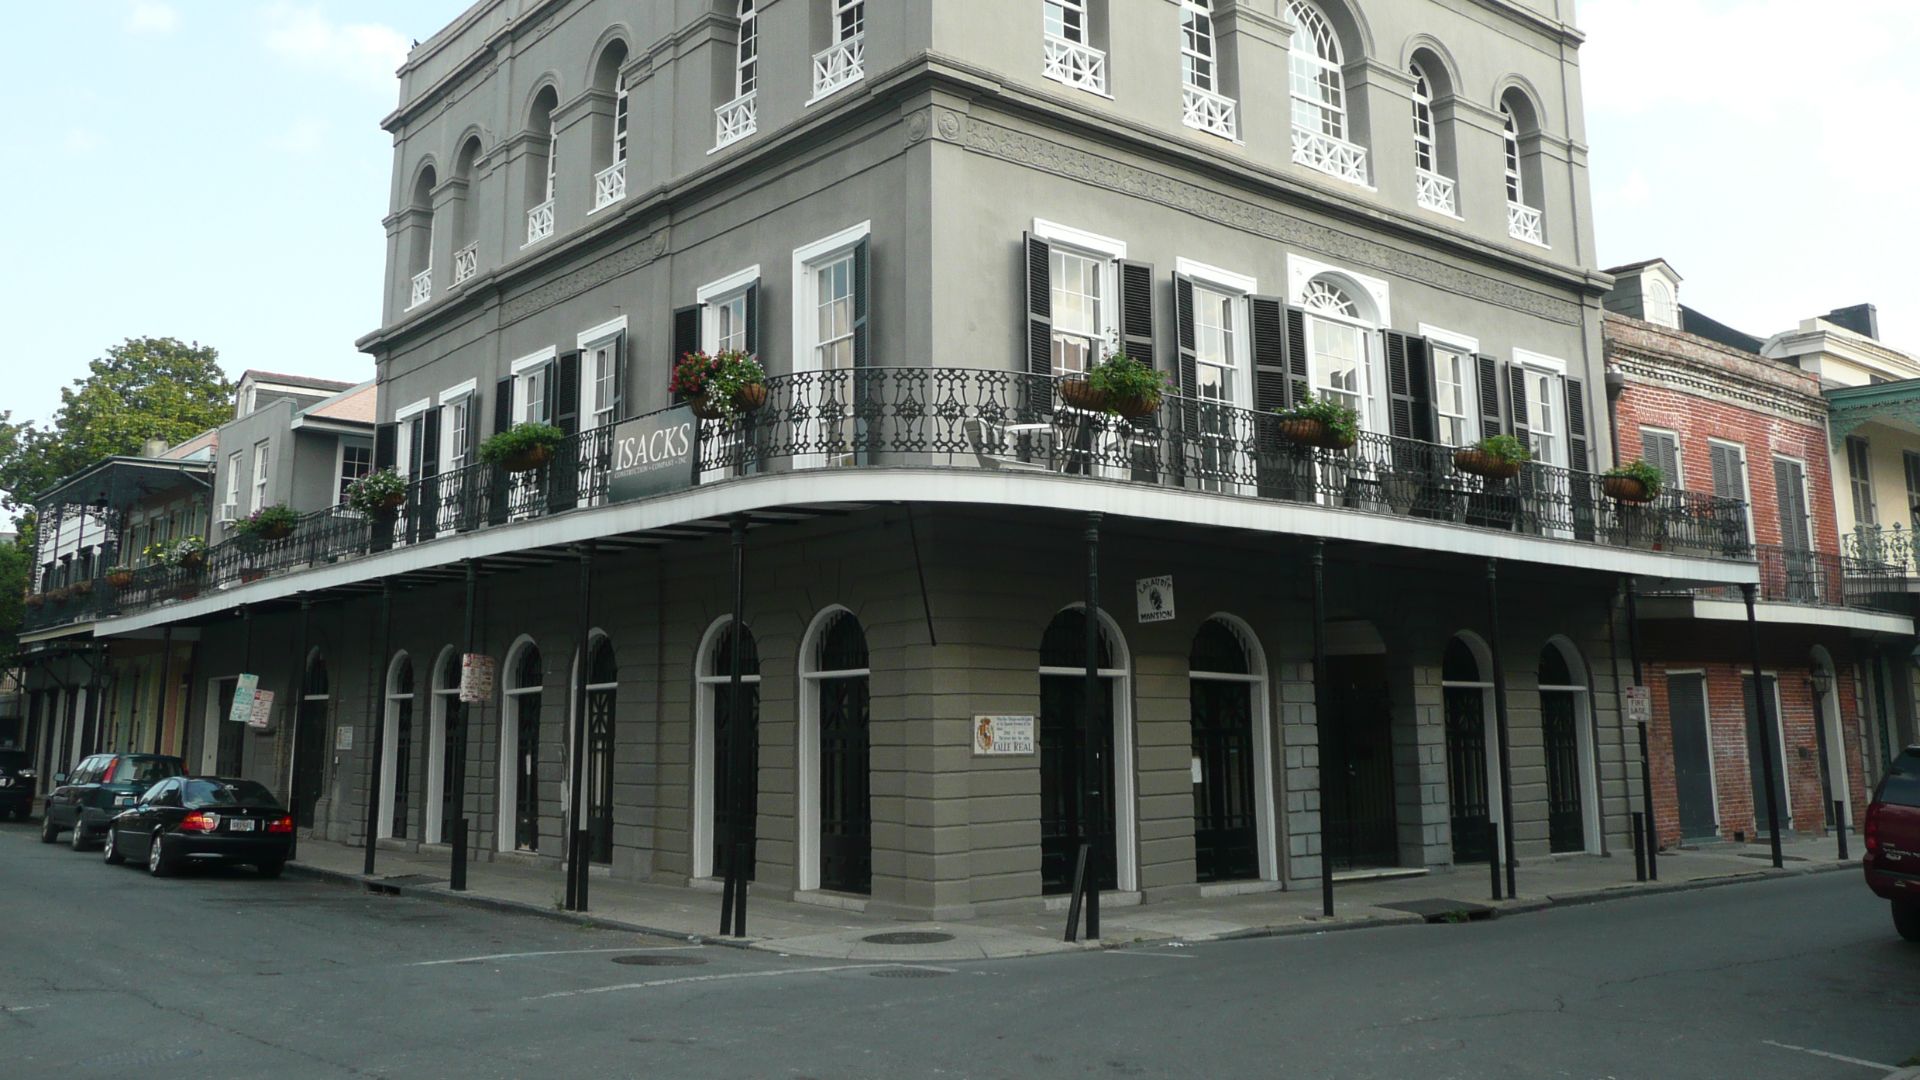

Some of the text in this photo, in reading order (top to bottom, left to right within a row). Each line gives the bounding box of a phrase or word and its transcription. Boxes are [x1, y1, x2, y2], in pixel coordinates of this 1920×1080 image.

[615, 423, 690, 471] ISACKS
[1140, 609, 1174, 619] MANSION
[993, 741, 1033, 752] CALLE REAL
